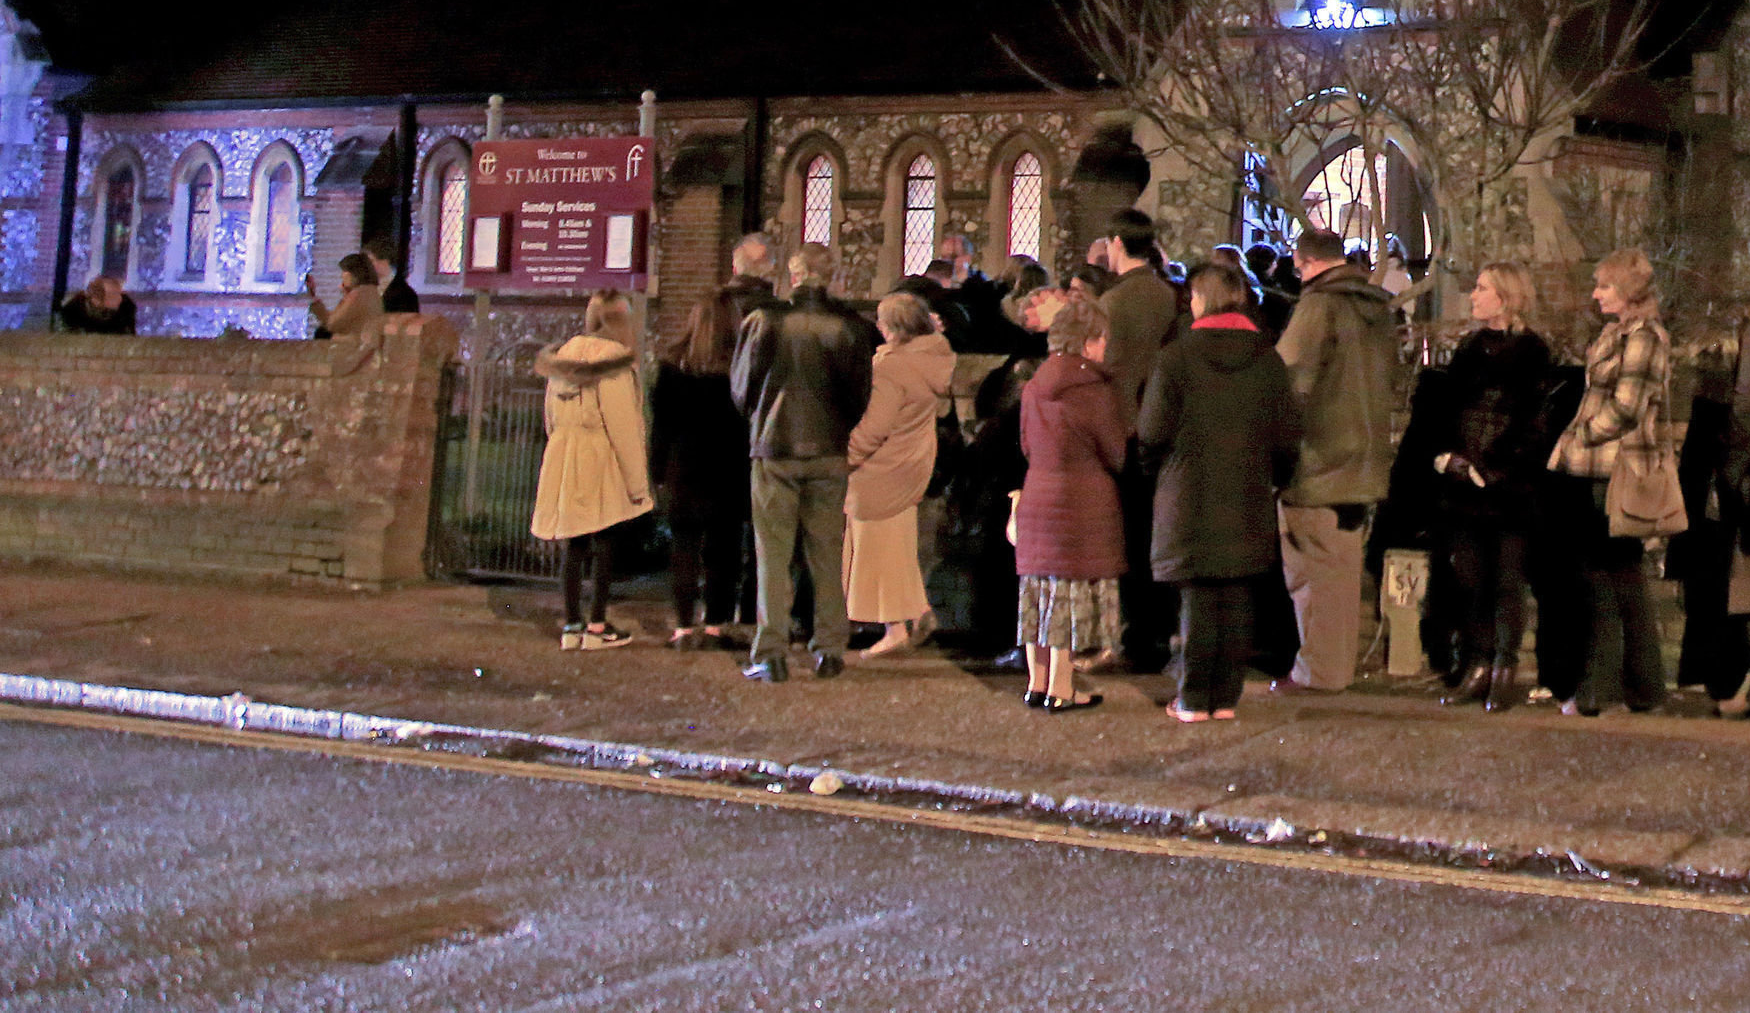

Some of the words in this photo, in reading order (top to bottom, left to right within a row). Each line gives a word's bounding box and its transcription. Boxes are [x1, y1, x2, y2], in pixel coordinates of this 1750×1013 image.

[537, 149, 576, 160] Welcome
[577, 150, 588, 160] to
[505, 167, 524, 184] ST
[526, 166, 617, 184] MATTHEW'S
[521, 201, 555, 215] Sunday
[556, 200, 597, 212] Services
